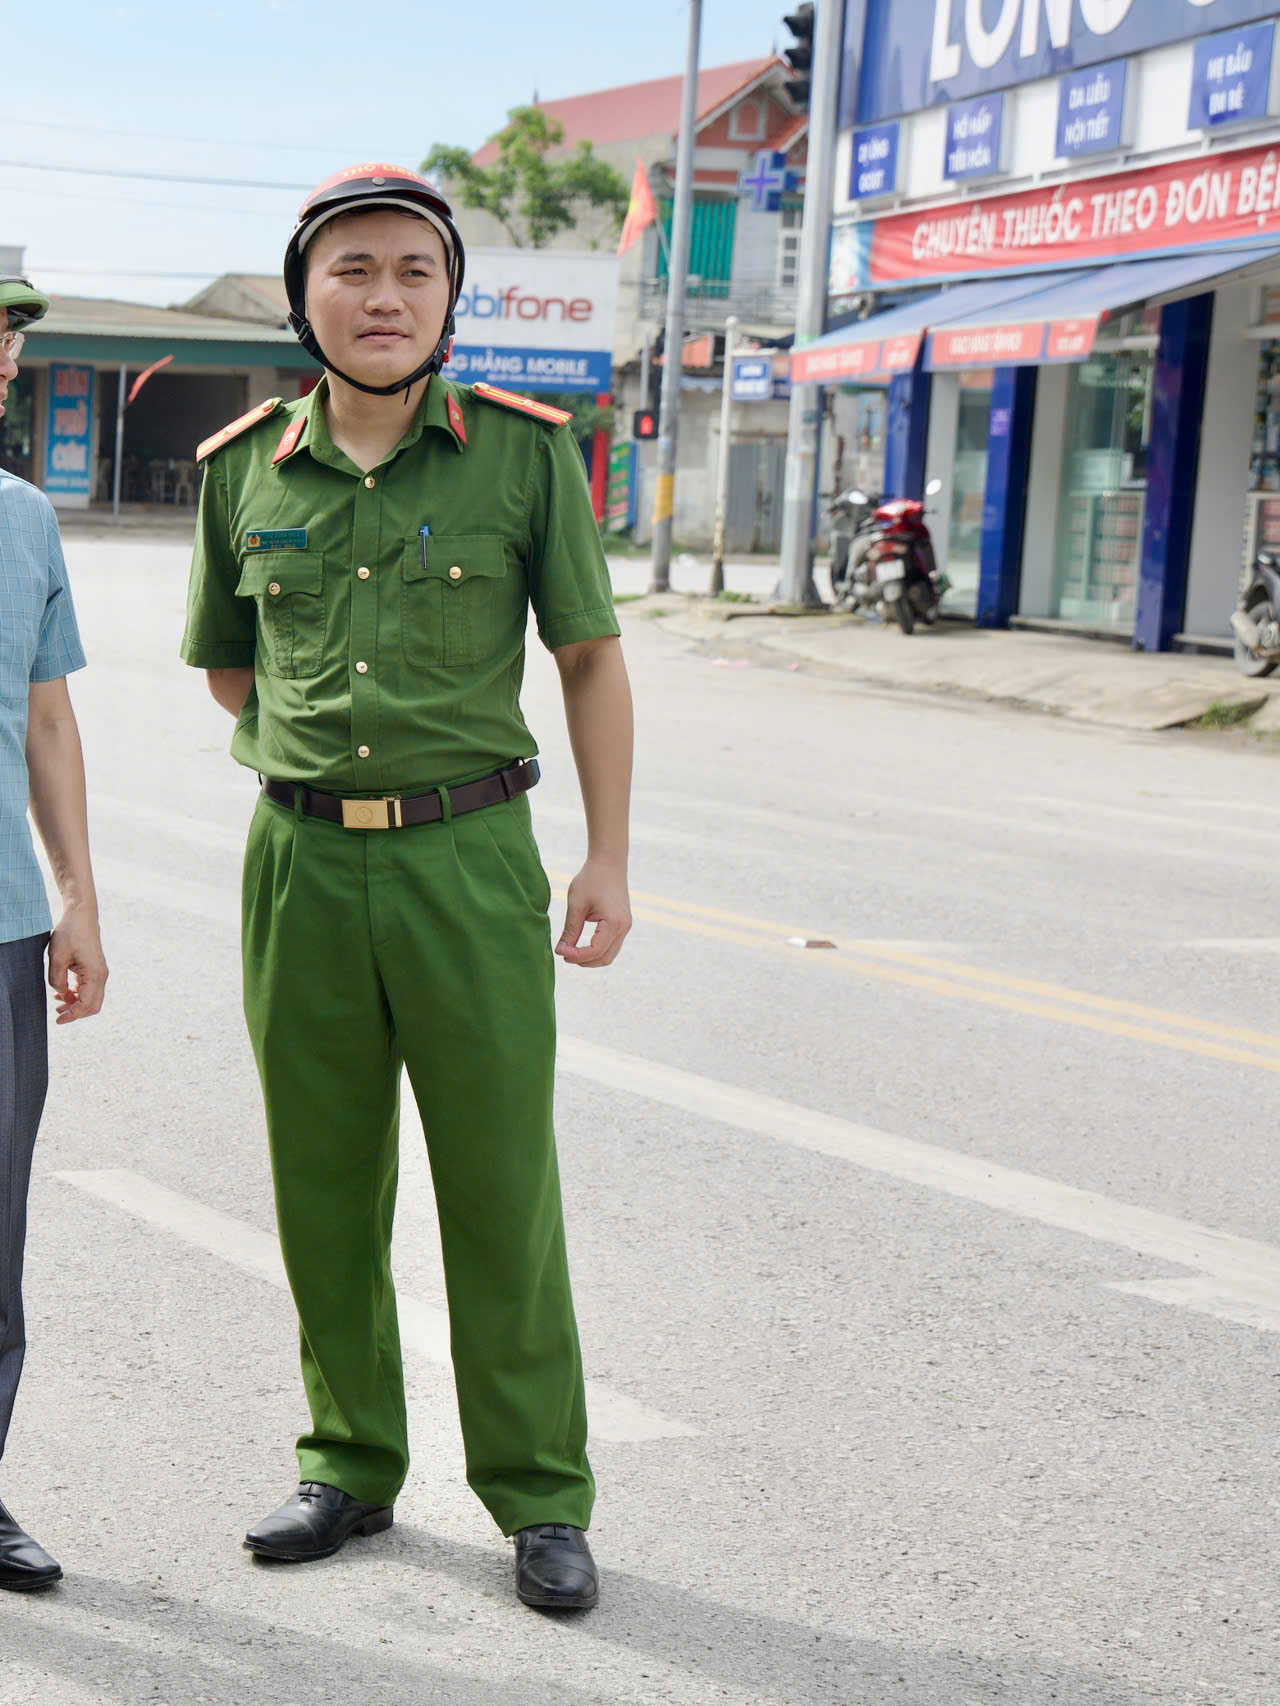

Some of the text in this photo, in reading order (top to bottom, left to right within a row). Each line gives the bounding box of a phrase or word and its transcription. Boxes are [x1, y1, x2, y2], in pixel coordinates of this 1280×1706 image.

[911, 154, 1280, 260] CHUYÊN THUỐC THEO ĐƠN BỆ
[453, 284, 593, 322] obifone
[526, 358, 589, 377] MOBILE
